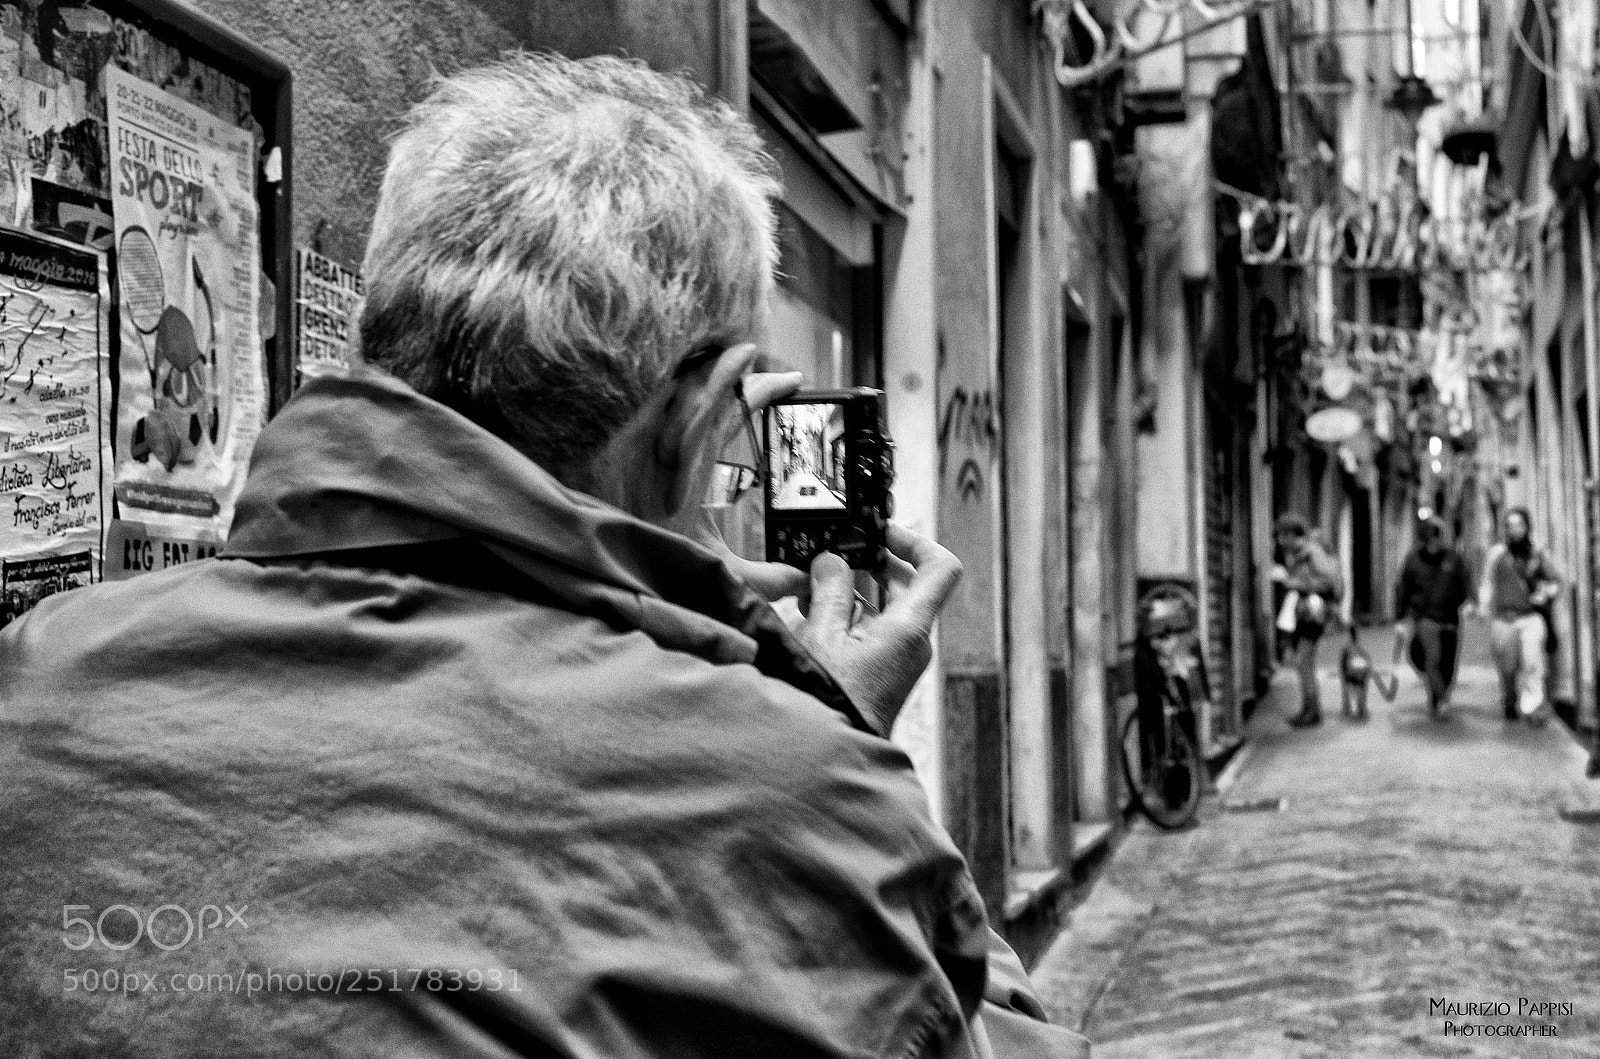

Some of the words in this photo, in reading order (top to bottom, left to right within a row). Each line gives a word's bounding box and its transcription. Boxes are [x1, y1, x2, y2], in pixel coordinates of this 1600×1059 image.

[118, 126, 158, 165] FESTA
[163, 146, 204, 183] DELLO
[119, 156, 204, 223] SPORT
[9, 252, 65, 292] maggio
[67, 266, 97, 286] 2016
[39, 444, 92, 490] Libertaria
[13, 494, 61, 530] Francisco
[65, 480, 96, 511] Ferrer
[123, 538, 154, 572] BIG
[163, 542, 190, 569] FAT
